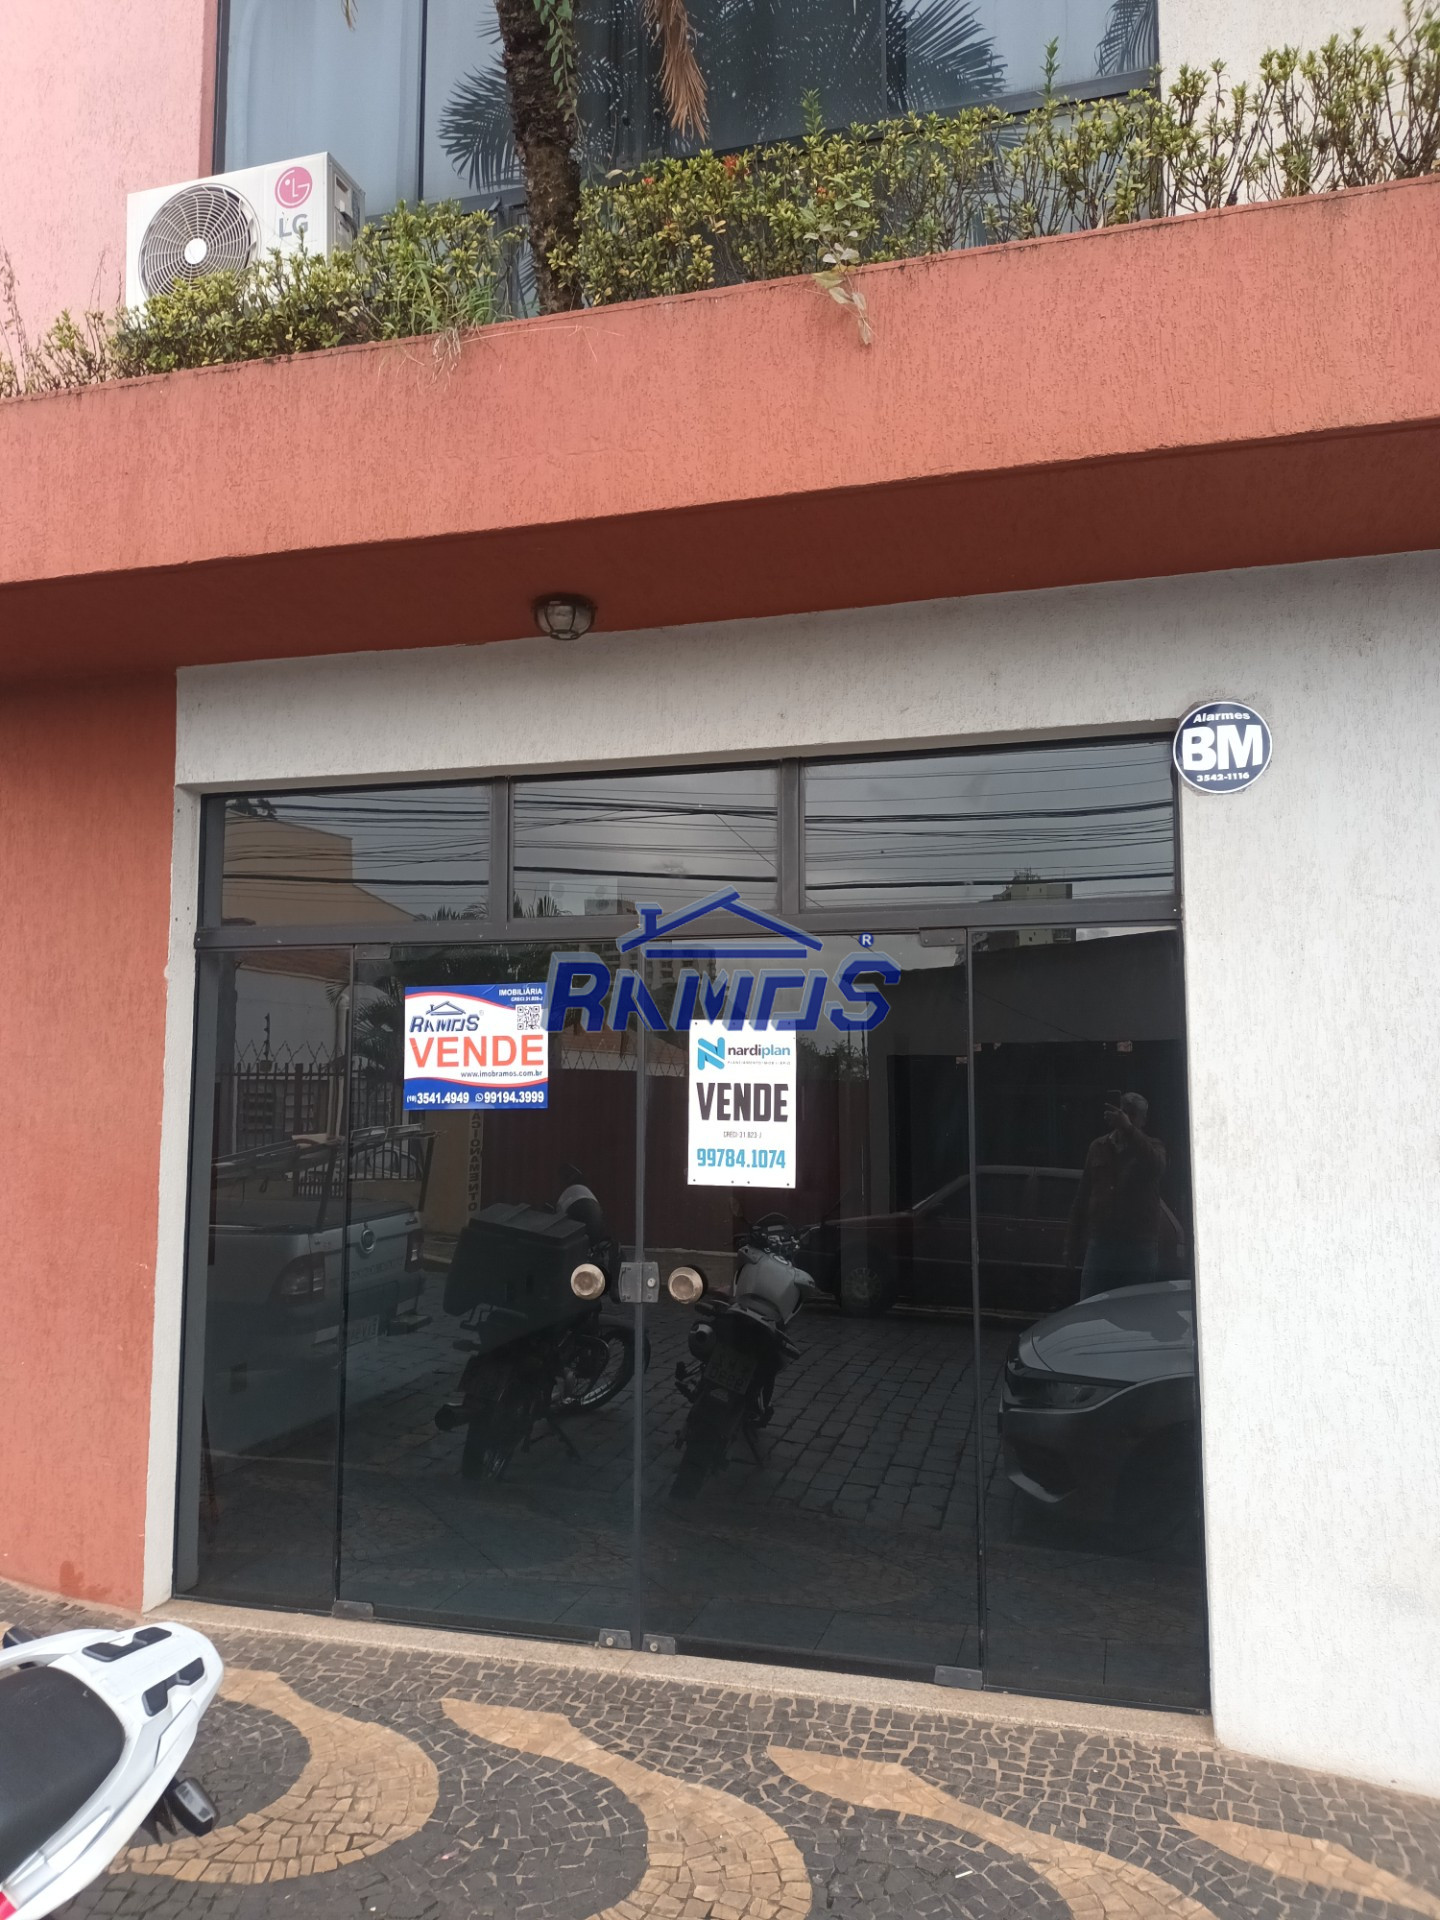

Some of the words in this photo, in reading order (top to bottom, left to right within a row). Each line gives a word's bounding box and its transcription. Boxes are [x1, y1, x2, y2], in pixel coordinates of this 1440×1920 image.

[278, 213, 309, 239] LG
[1193, 712, 1250, 723] Alarmes
[1182, 724, 1263, 771] BM
[1196, 772, 1250, 782] 3542-1116
[498, 986, 543, 997] IMOBILIÁRIA
[409, 1014, 480, 1033] RAMOS
[409, 1034, 544, 1068] VENDE
[727, 1044, 791, 1059] nardiplan
[460, 1070, 543, 1078] www.imobramos.com.br
[484, 1091, 545, 1104] 99194.3999
[696, 1082, 789, 1122] VENDE
[697, 1148, 786, 1169] 99784.1074
